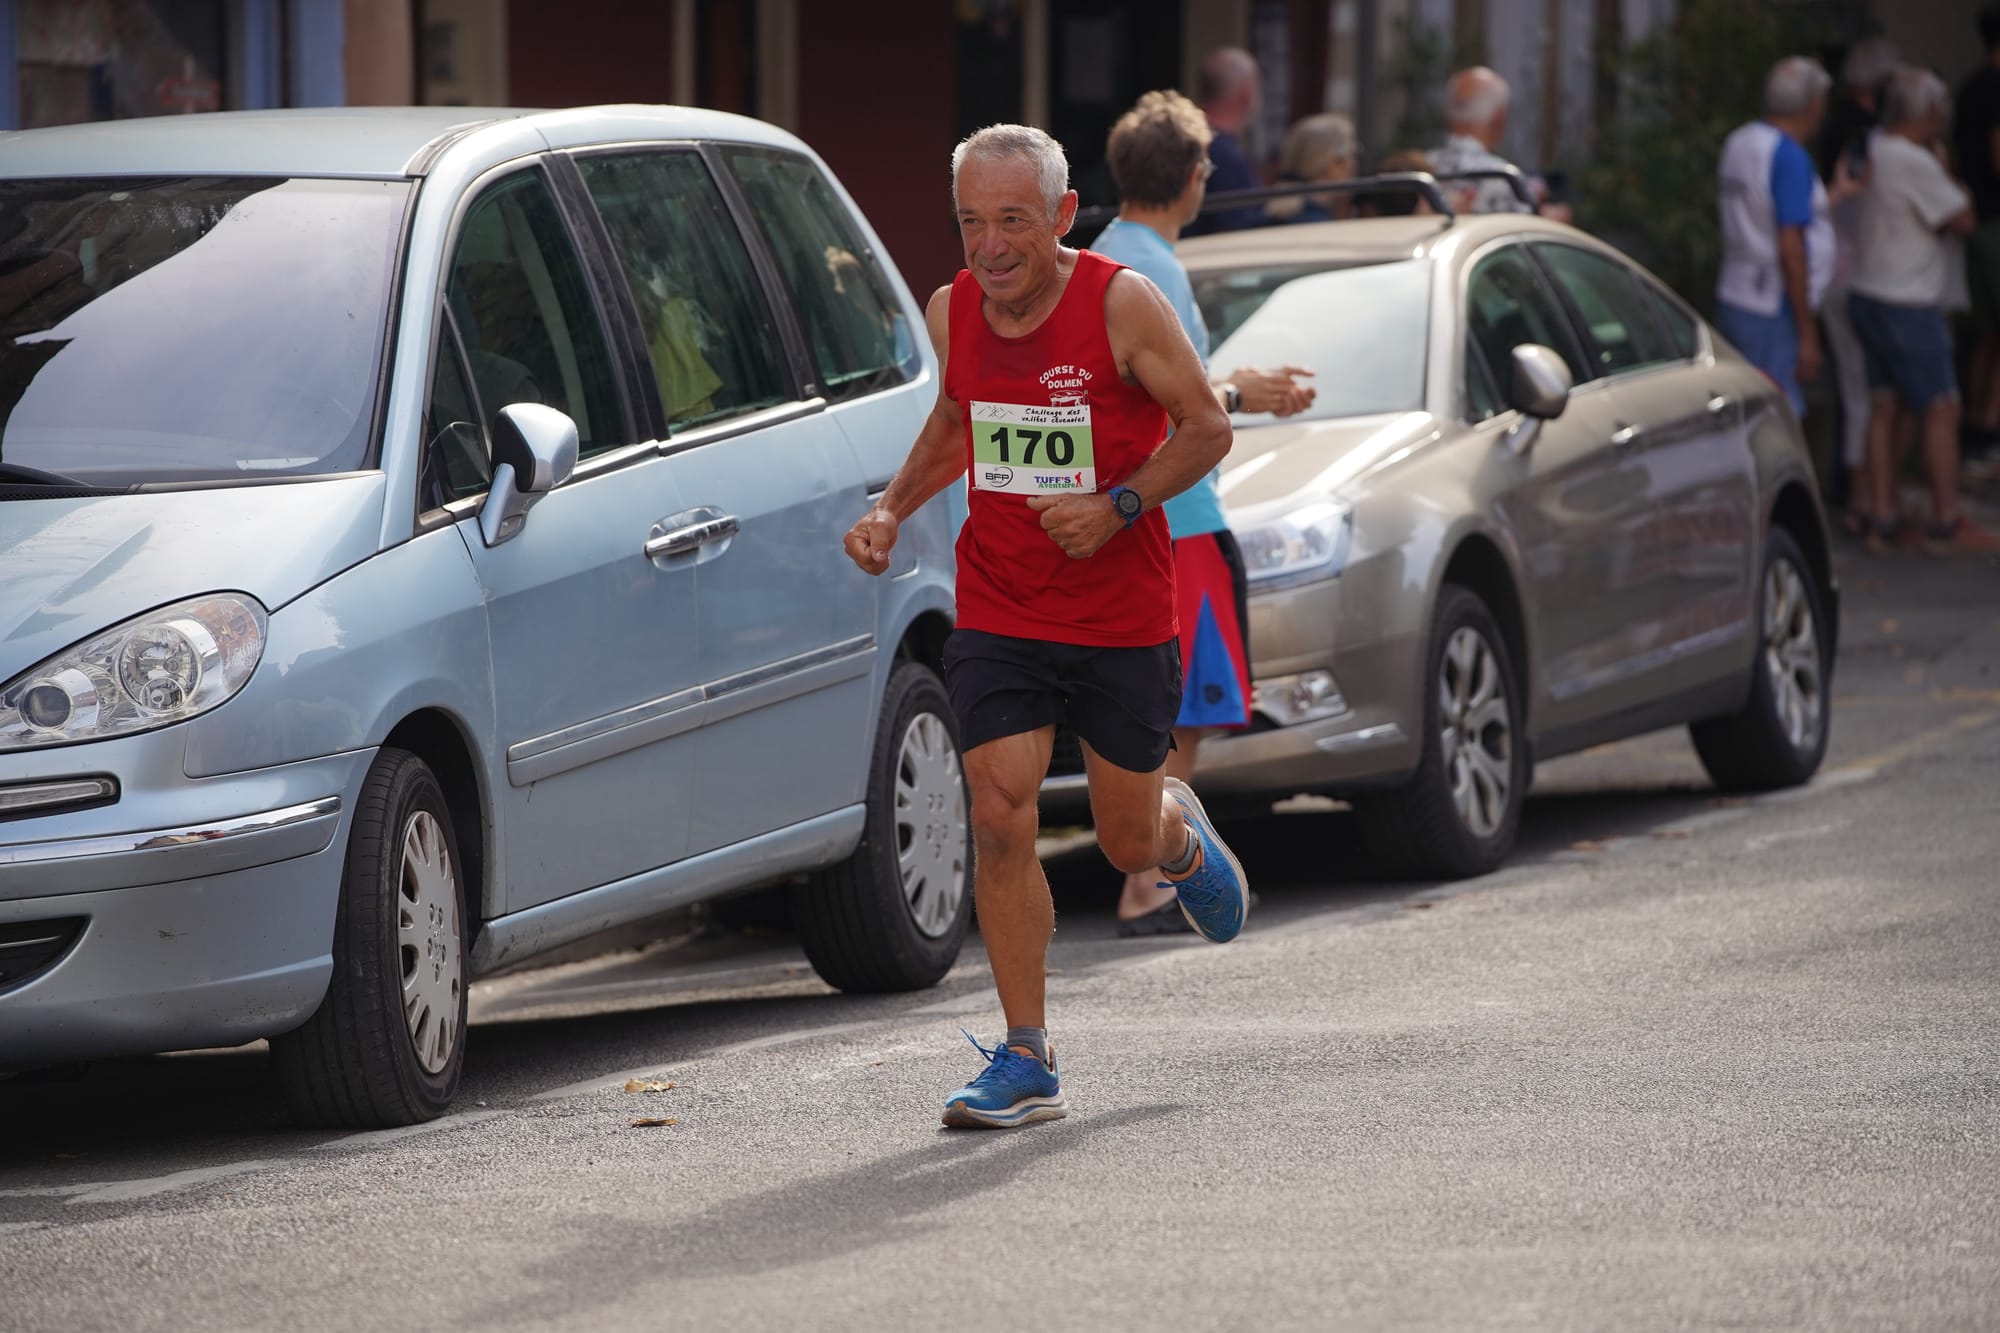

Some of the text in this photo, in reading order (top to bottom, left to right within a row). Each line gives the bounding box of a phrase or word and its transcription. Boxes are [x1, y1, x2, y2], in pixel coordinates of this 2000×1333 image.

[1040, 365, 1093, 384] COURSE DU
[1048, 379, 1083, 389] DOLMEN
[1025, 408, 1062, 417] Challenge
[990, 427, 1075, 466] 170
[985, 472, 1010, 481] BFP
[1034, 475, 1071, 484] TUFF'S
